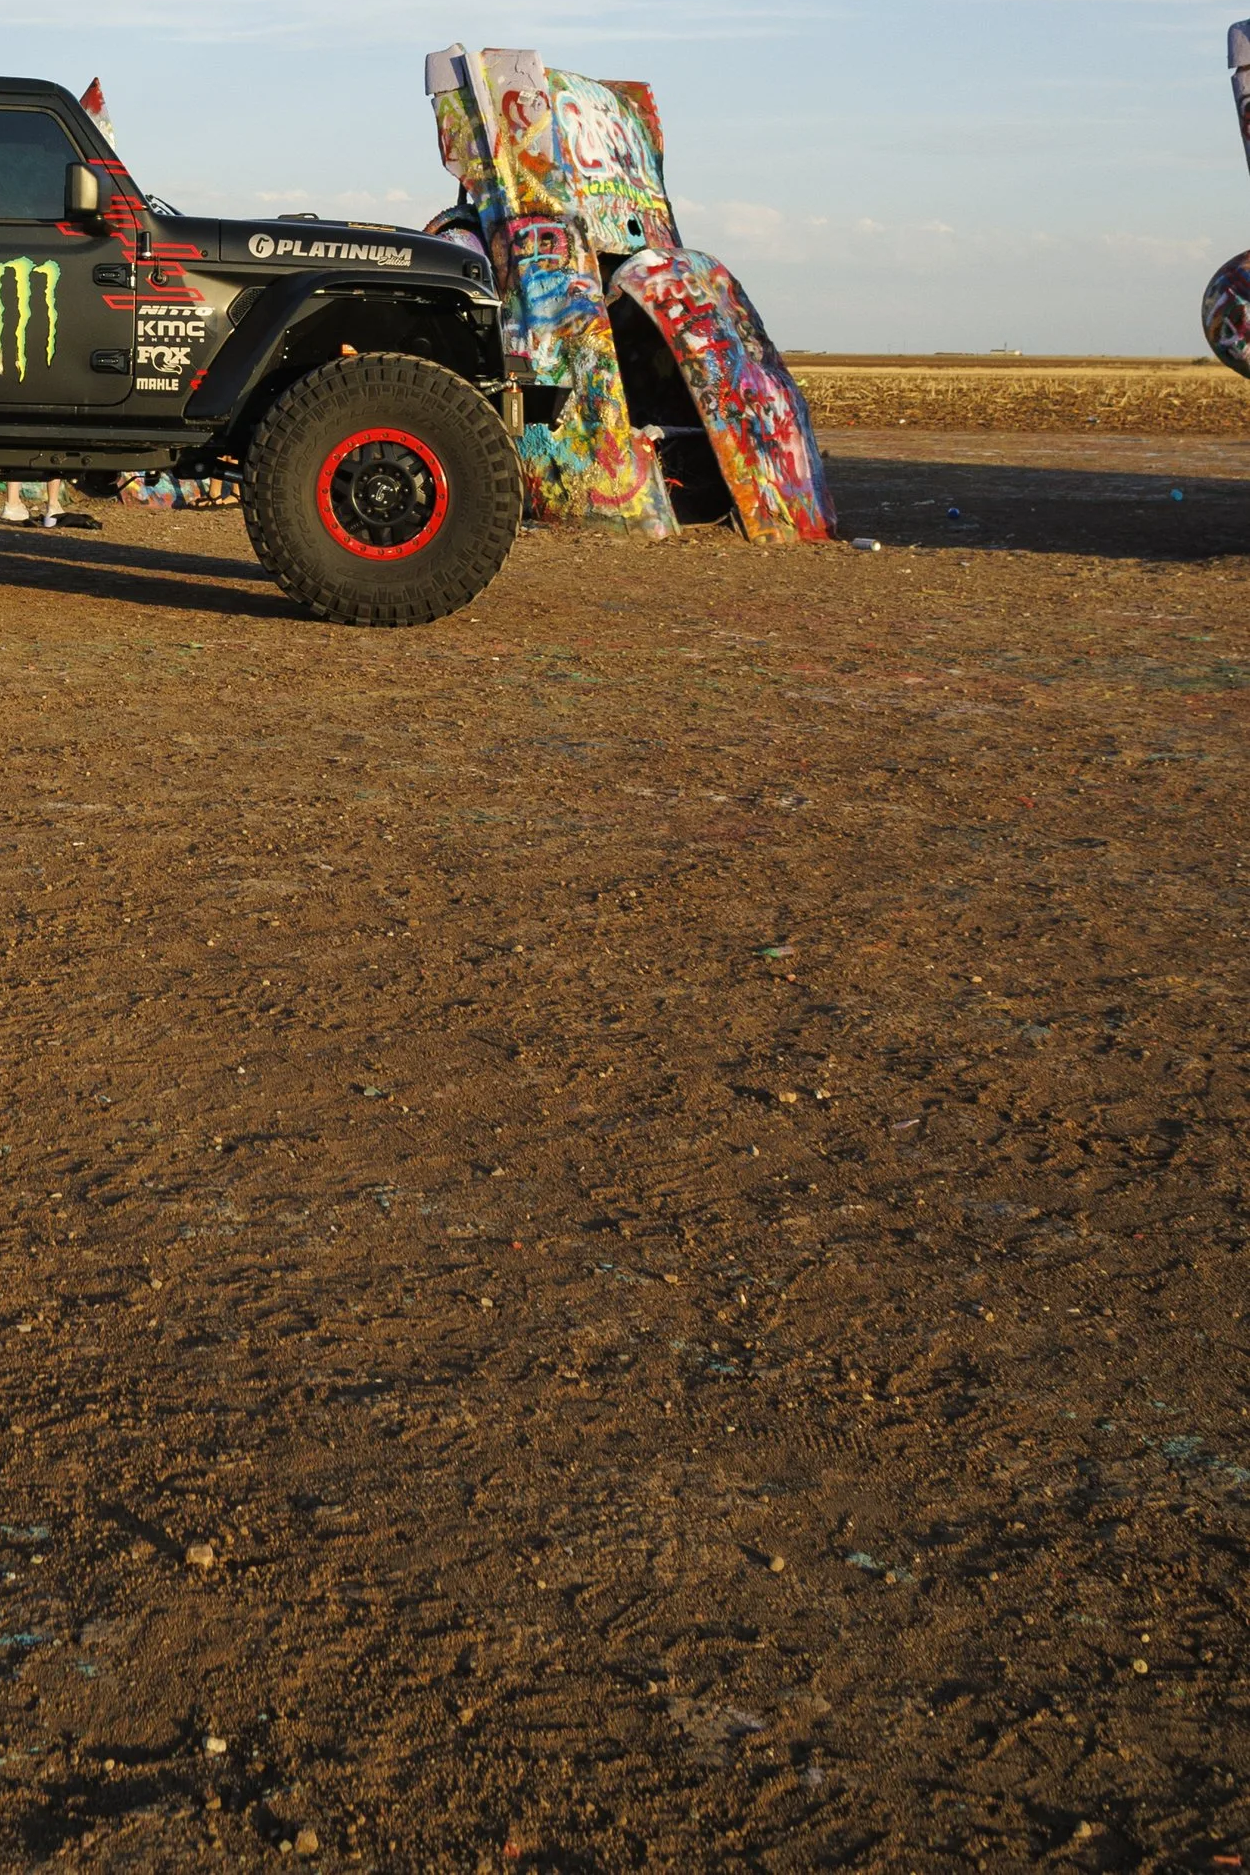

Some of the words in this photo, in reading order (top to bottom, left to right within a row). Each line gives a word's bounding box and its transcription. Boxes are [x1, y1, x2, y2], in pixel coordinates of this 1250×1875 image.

[276, 239, 413, 261] PLATINUM
[377, 256, 411, 267] Edition
[138, 305, 215, 317] NITTO
[137, 346, 191, 374] FOX
[136, 377, 179, 391] MAHLE
